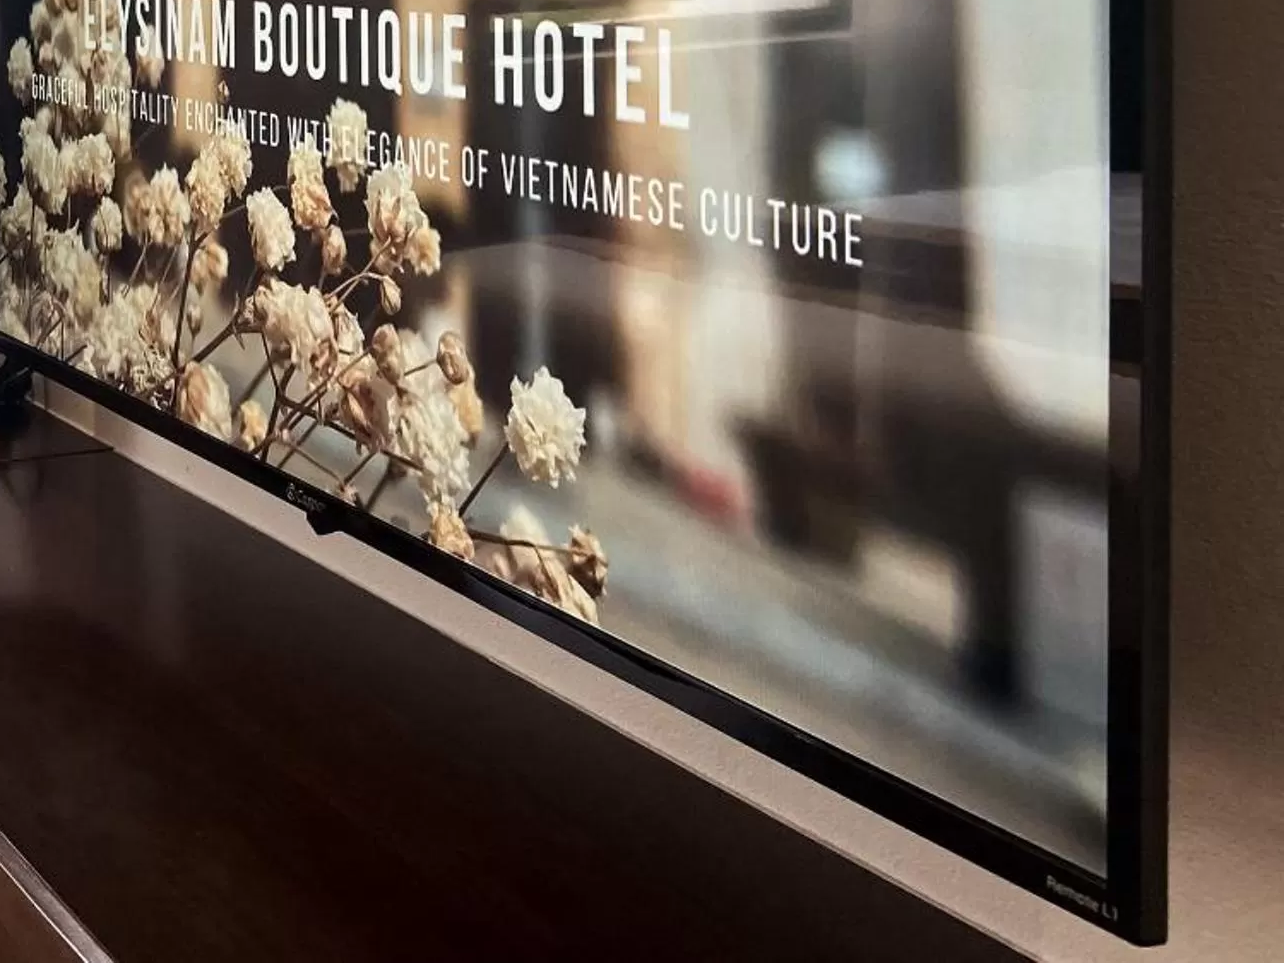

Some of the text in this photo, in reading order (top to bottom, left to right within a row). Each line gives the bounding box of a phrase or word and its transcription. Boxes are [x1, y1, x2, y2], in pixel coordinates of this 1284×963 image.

[253, 0, 467, 101] BOUTIQUE
[493, 14, 691, 130] HOTEL
[31, 73, 88, 110] GRACEFUL
[185, 98, 280, 147] ENCHANTED
[287, 114, 333, 158] WITH
[342, 124, 451, 183] ELEGANCE
[461, 145, 489, 189] OF
[500, 150, 685, 230] VIETNAMESE
[699, 186, 864, 268] CULTURE
